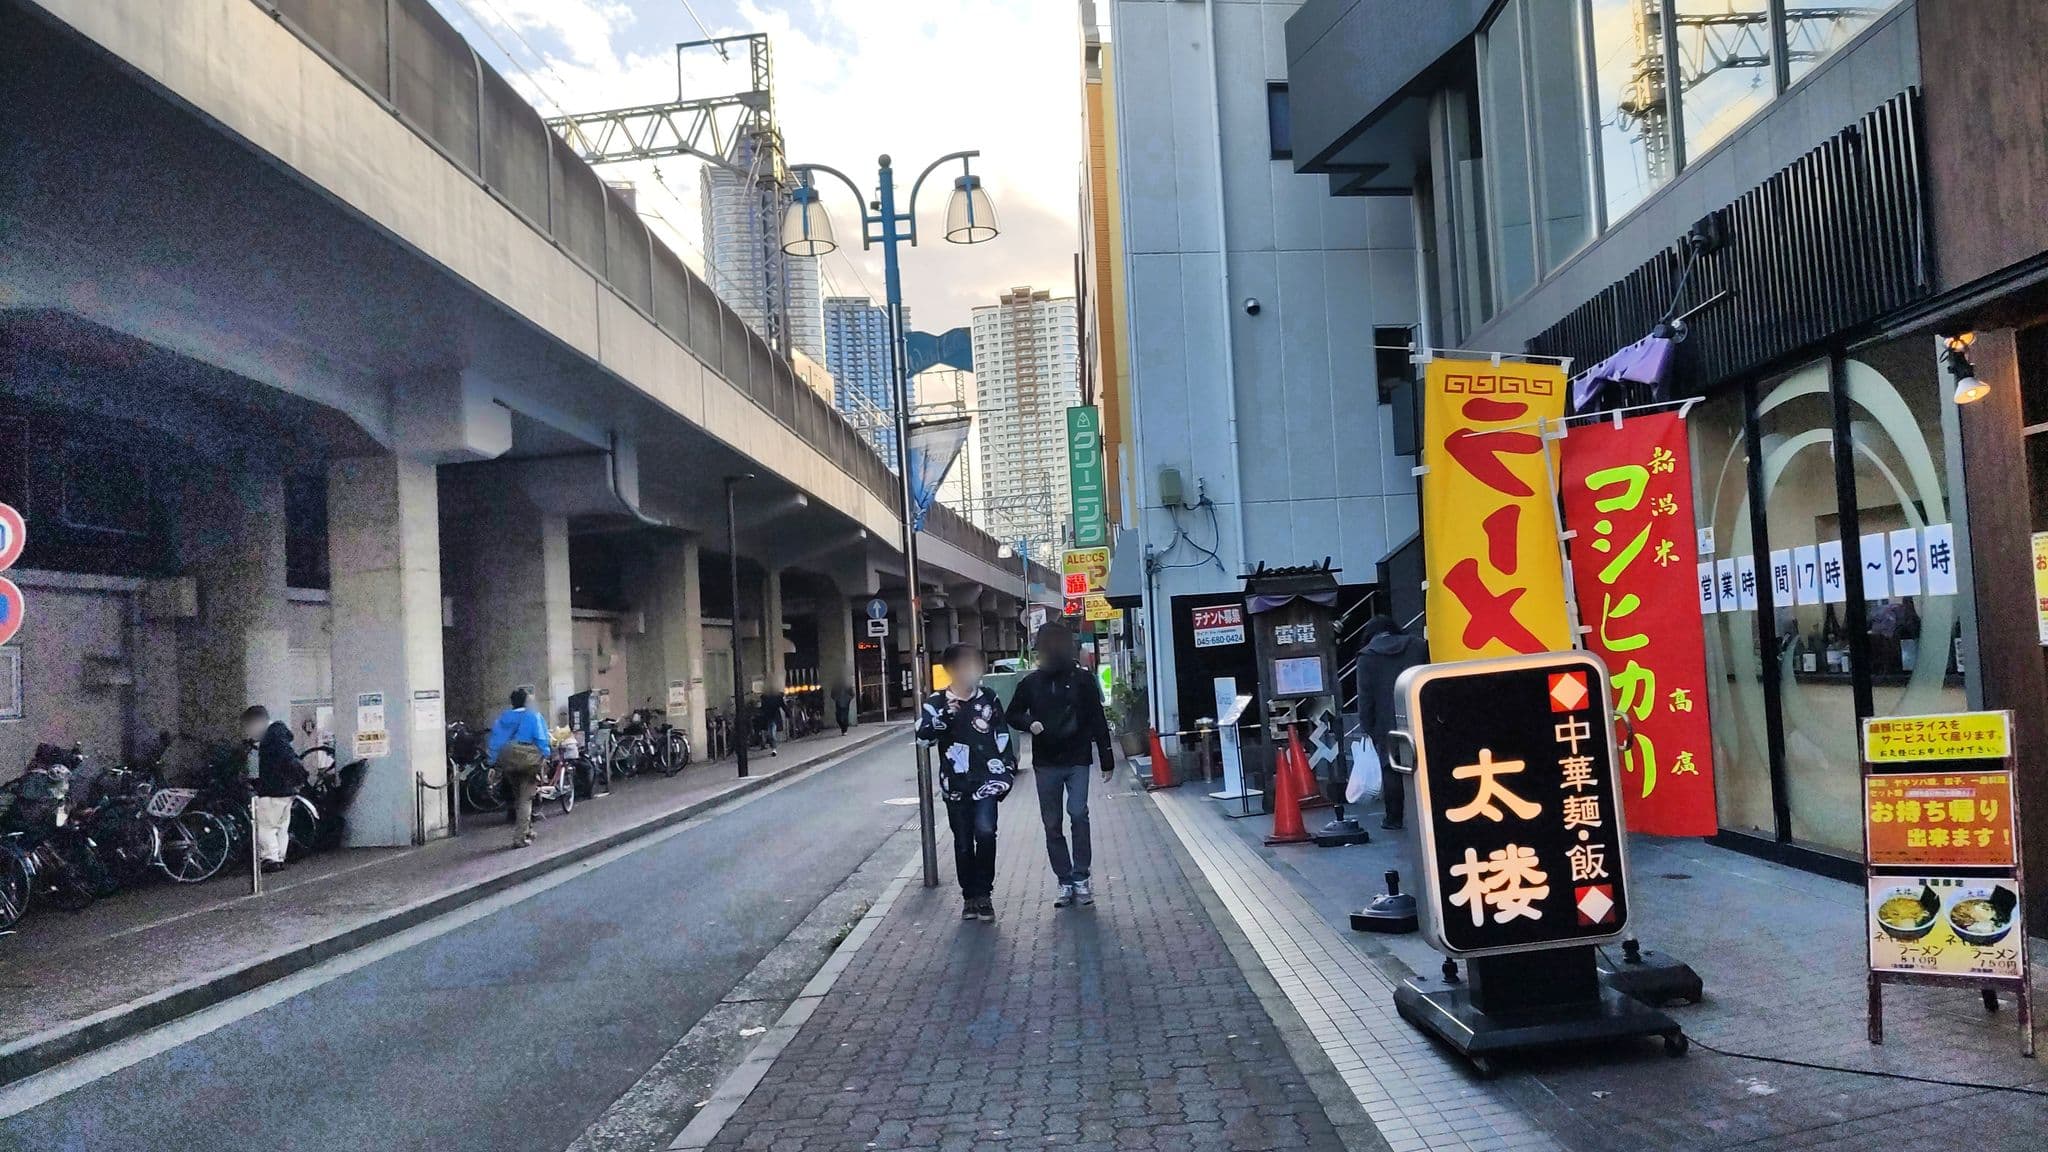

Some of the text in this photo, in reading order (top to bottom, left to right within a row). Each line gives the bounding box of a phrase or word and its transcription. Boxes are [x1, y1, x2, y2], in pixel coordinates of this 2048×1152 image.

[1648, 446, 1680, 568] 新潟米
[1067, 552, 1105, 565] ALECCS
[1195, 609, 1241, 626] テナント募集
[1197, 634, 1243, 646] 045-680-0424
[1585, 464, 1657, 799] コシヒカリ
[1555, 715, 1609, 882] 中華麺・飯
[1870, 799, 1999, 823] お持ち帰り
[1445, 748, 1550, 927] 太楼
